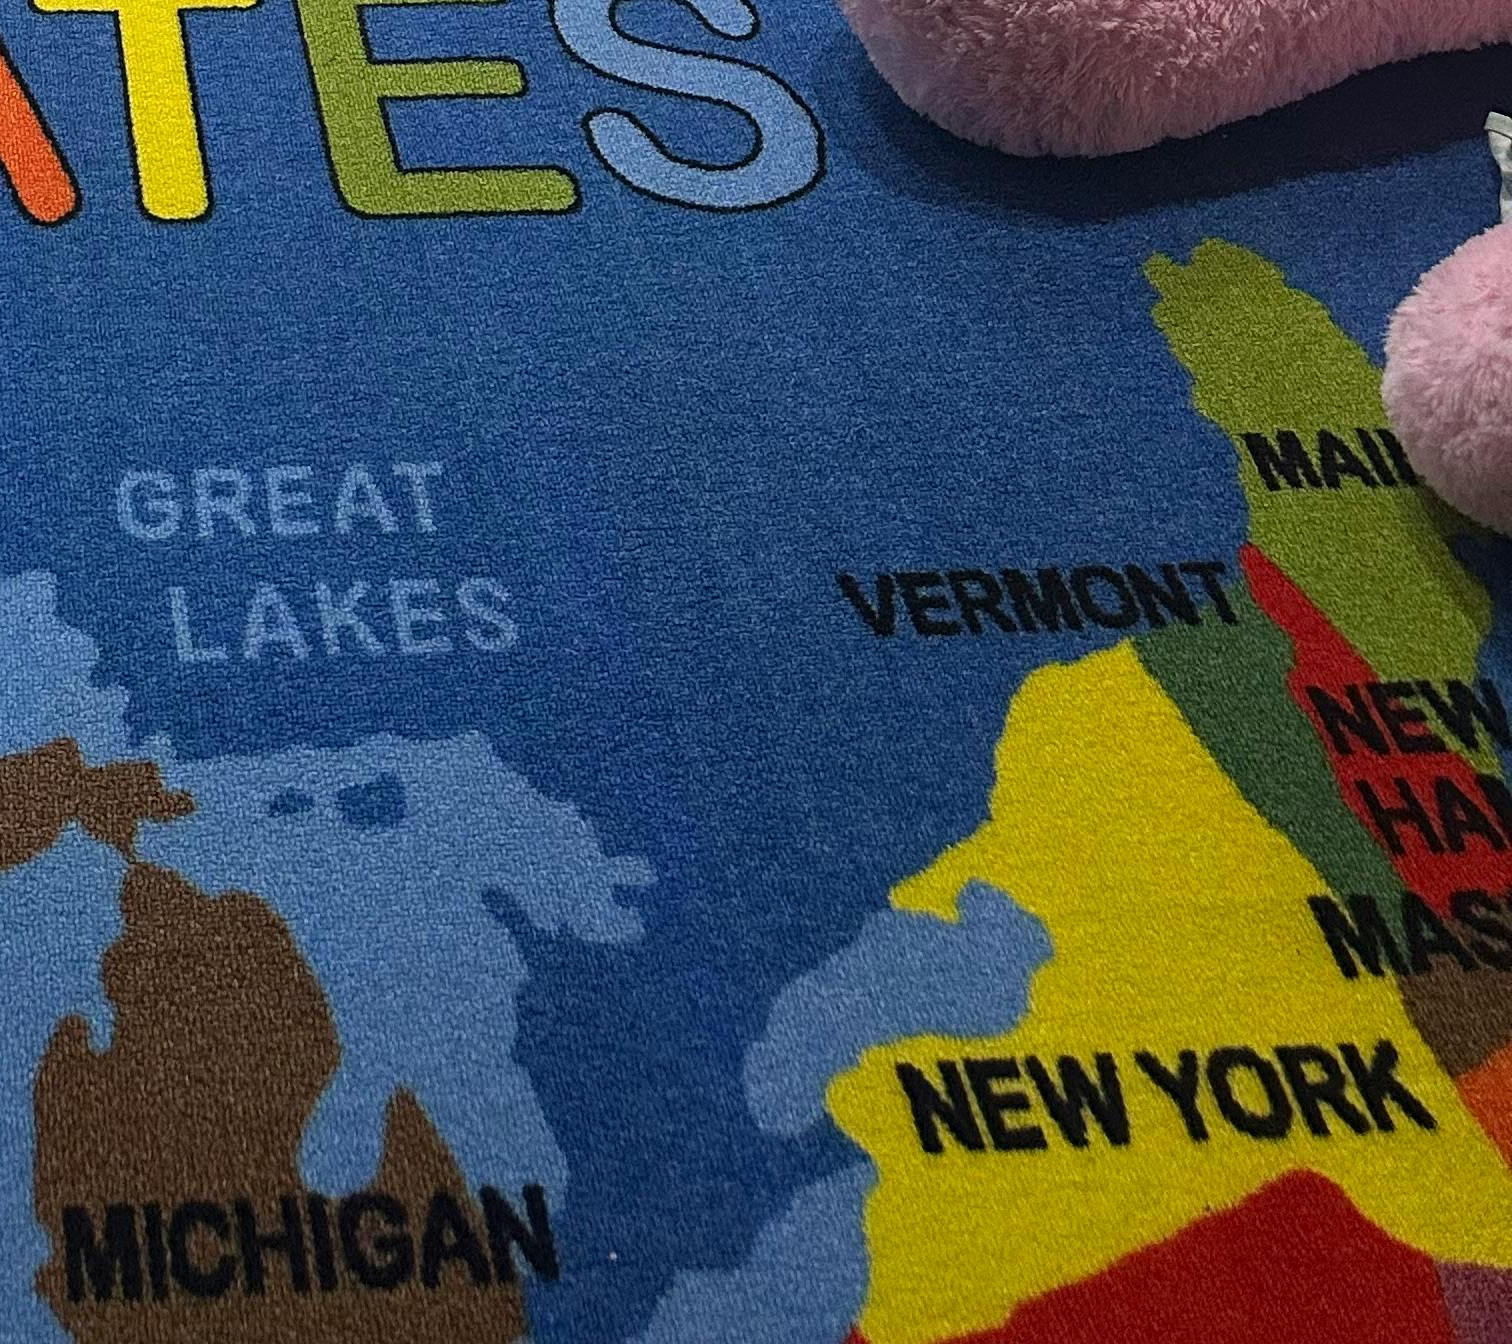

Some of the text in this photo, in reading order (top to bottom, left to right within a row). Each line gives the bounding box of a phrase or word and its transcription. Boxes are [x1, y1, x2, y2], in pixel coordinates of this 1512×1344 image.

[117, 461, 446, 542] GREAT
[168, 574, 522, 664] LAKES
[839, 560, 1241, 639] VERMONT
[896, 1040, 1437, 1157] NEW YORK
[62, 1183, 563, 1304] MICHIGAN
